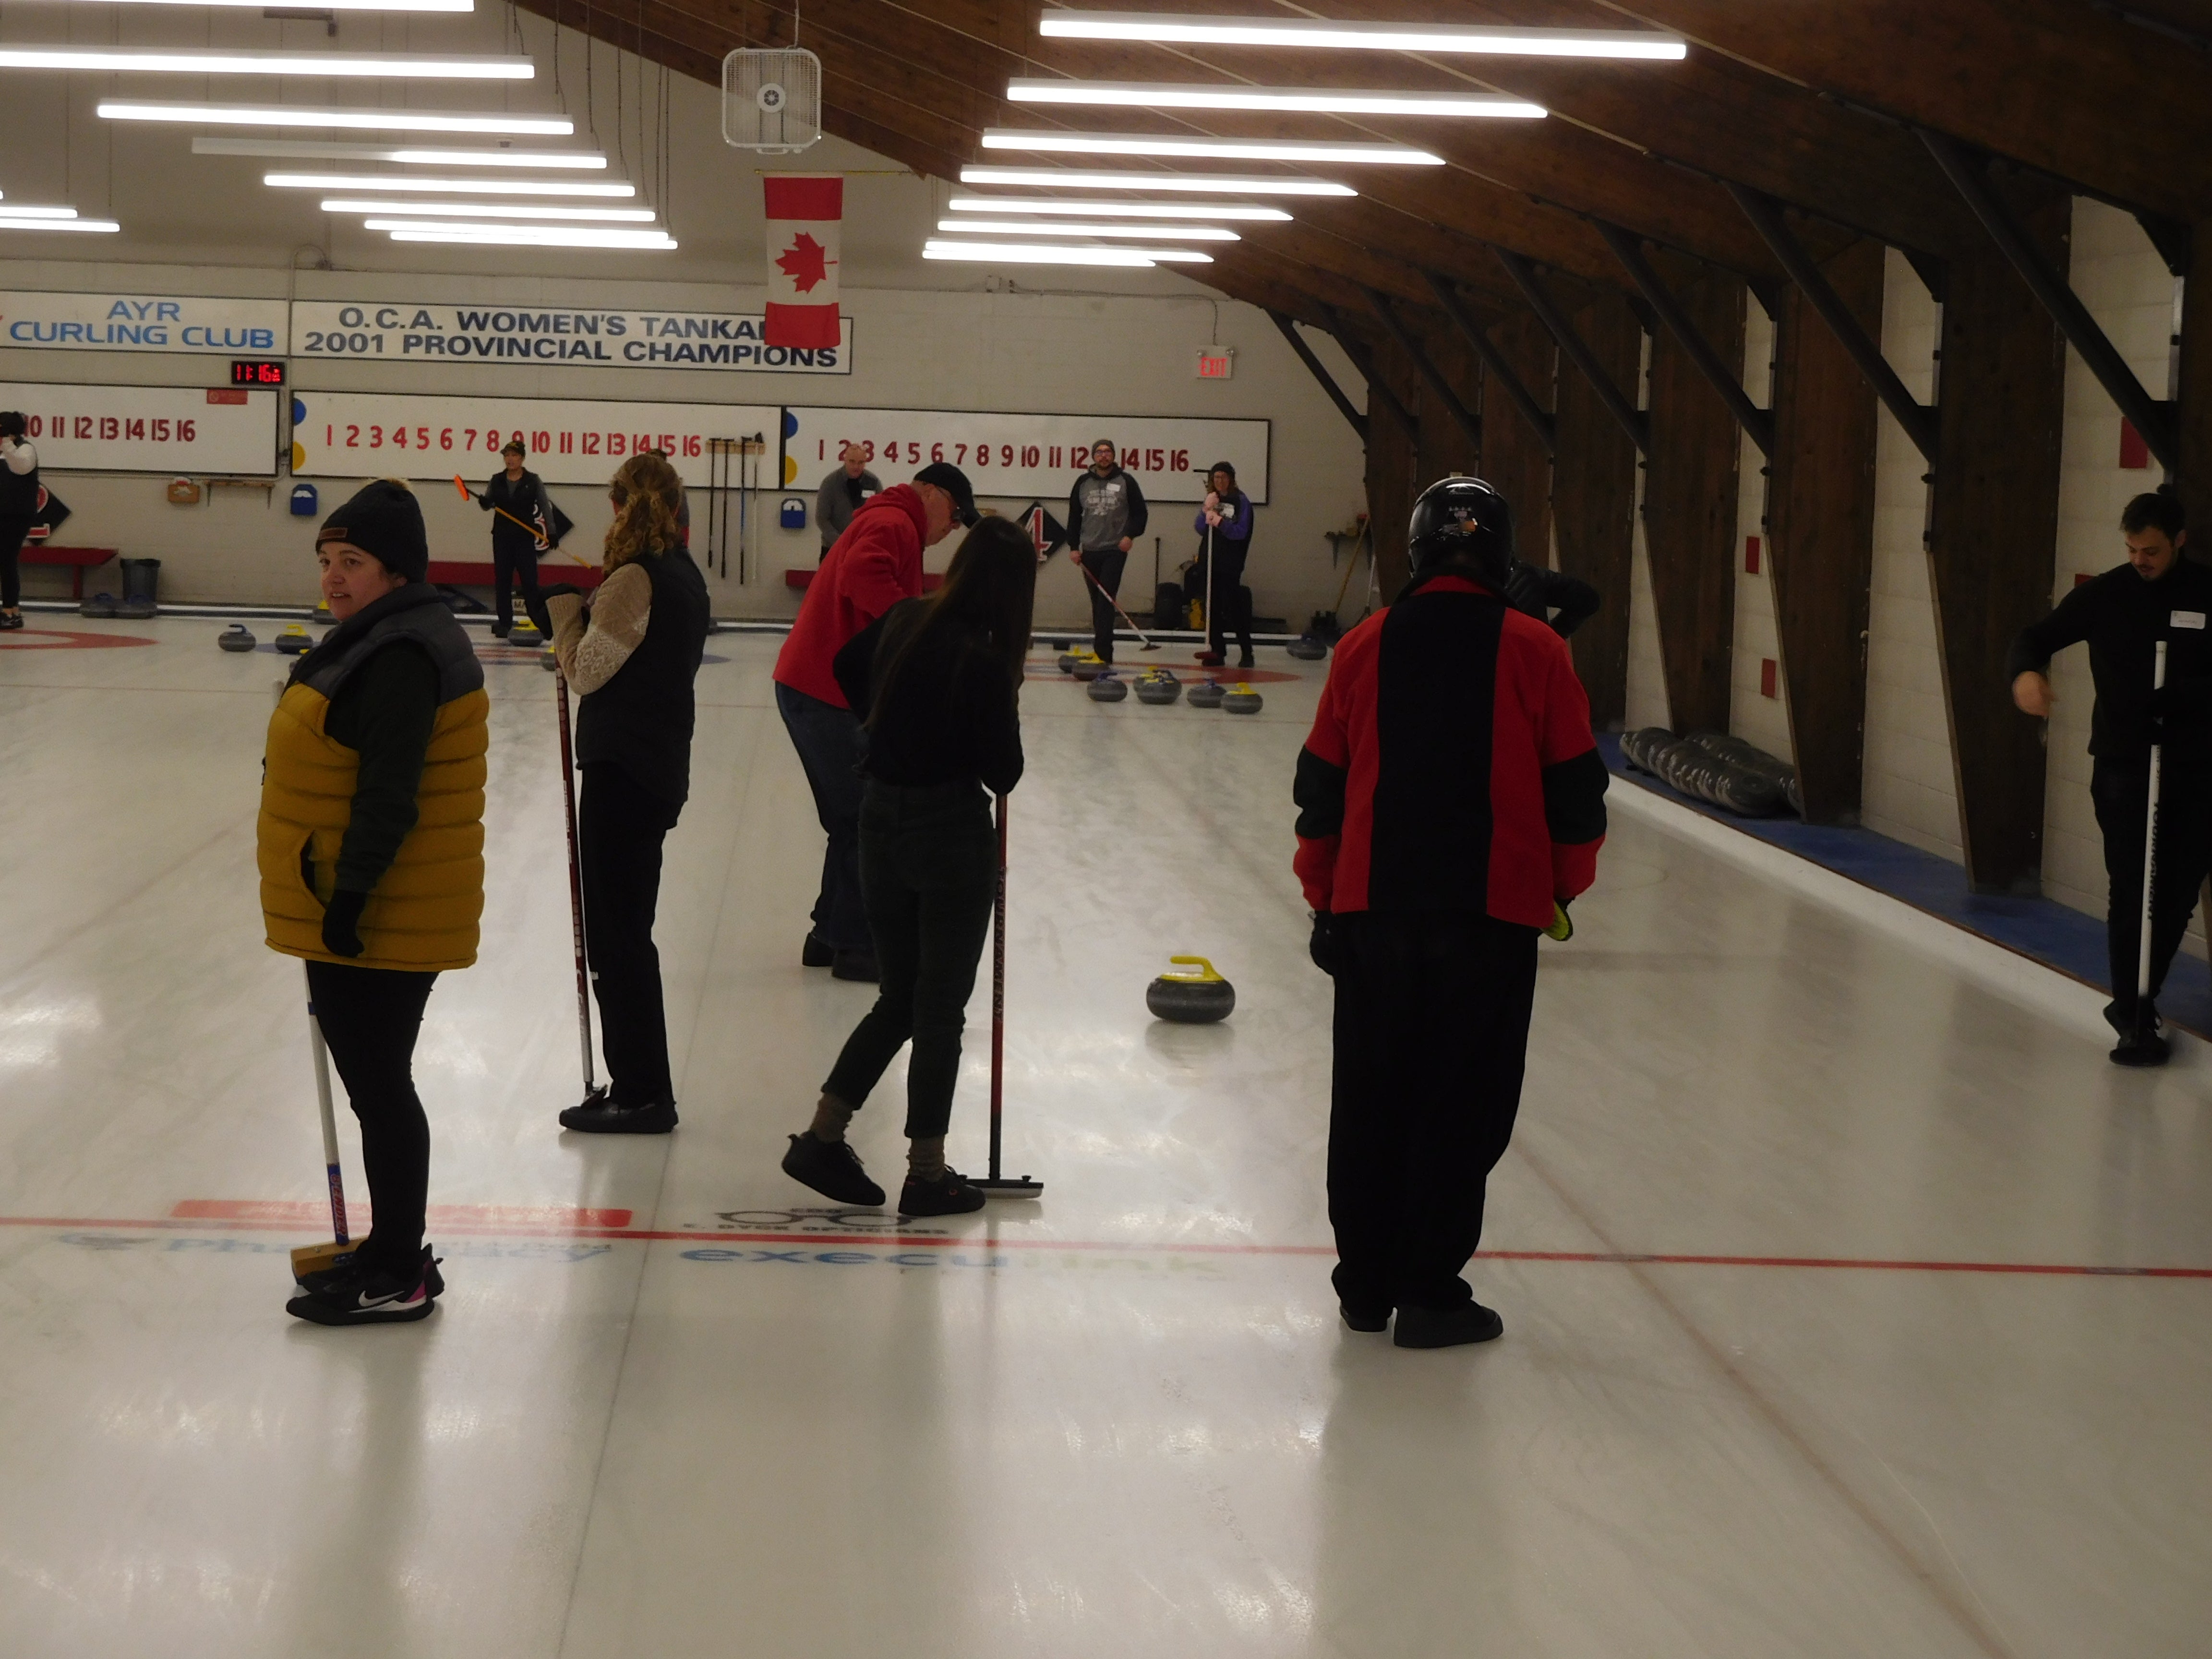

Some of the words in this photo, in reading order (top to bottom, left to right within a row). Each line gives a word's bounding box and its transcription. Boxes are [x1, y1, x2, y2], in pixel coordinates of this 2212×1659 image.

[107, 300, 181, 322] AYR
[338, 308, 443, 330] O.C.A.
[456, 310, 627, 336] WOMEN'S
[640, 317, 766, 340] TANKA
[10, 320, 168, 346] CURLING
[181, 326, 275, 349] CLUB
[304, 331, 384, 353] 2001
[402, 334, 612, 361] PROVINCIAL
[623, 341, 837, 367] CHAMPIONS
[51, 416, 65, 438] 11
[74, 416, 93, 439] 12
[99, 417, 119, 440] 13
[125, 418, 145, 441] 14
[151, 419, 171, 442] 15
[176, 420, 196, 442] 16
[327, 424, 333, 446] 1
[346, 424, 360, 447] 2
[369, 425, 384, 448] 3
[392, 426, 408, 448] 4
[416, 427, 430, 450] 5
[439, 427, 454, 451] 6
[464, 428, 477, 451] 7
[486, 429, 500, 452] 8
[532, 431, 551, 454] 10
[559, 431, 573, 454] 11
[582, 432, 600, 455] 12
[607, 433, 626, 456] 13
[632, 433, 651, 456] 14
[657, 434, 676, 457] 15
[682, 435, 701, 457] 16
[818, 439, 825, 461] 1
[883, 441, 899, 463] 4
[907, 442, 921, 465] 5
[930, 442, 944, 463] 6
[955, 443, 968, 465] 7
[976, 444, 990, 466] 8
[1001, 445, 1014, 468] 9
[1021, 445, 1041, 469] 10
[1048, 445, 1062, 469] 11
[1070, 446, 1090, 469] 12
[1120, 447, 1141, 470] 14
[1144, 448, 1166, 472] 15
[1170, 449, 1190, 472] 16
[994, 868, 1006, 1022] TOURNAMENT
